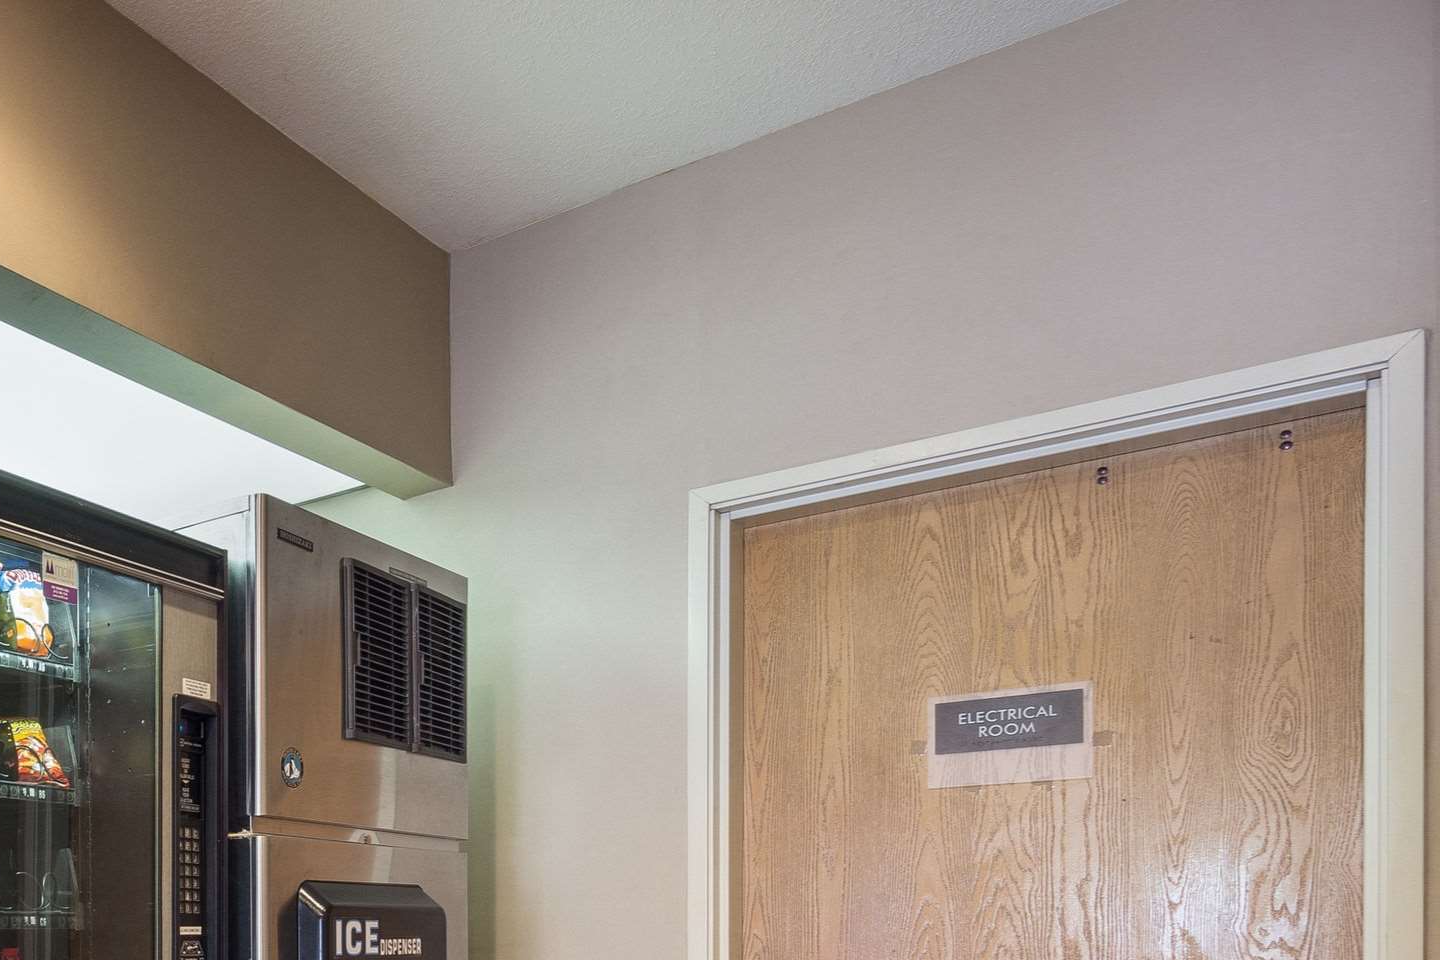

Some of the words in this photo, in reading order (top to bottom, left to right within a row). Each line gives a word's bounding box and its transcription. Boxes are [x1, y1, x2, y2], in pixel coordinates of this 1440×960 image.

[958, 704, 1057, 725] ELECTRICAL
[978, 722, 1036, 738] ROOM
[335, 919, 379, 956] ICE
[379, 938, 422, 956] DISPENSER
